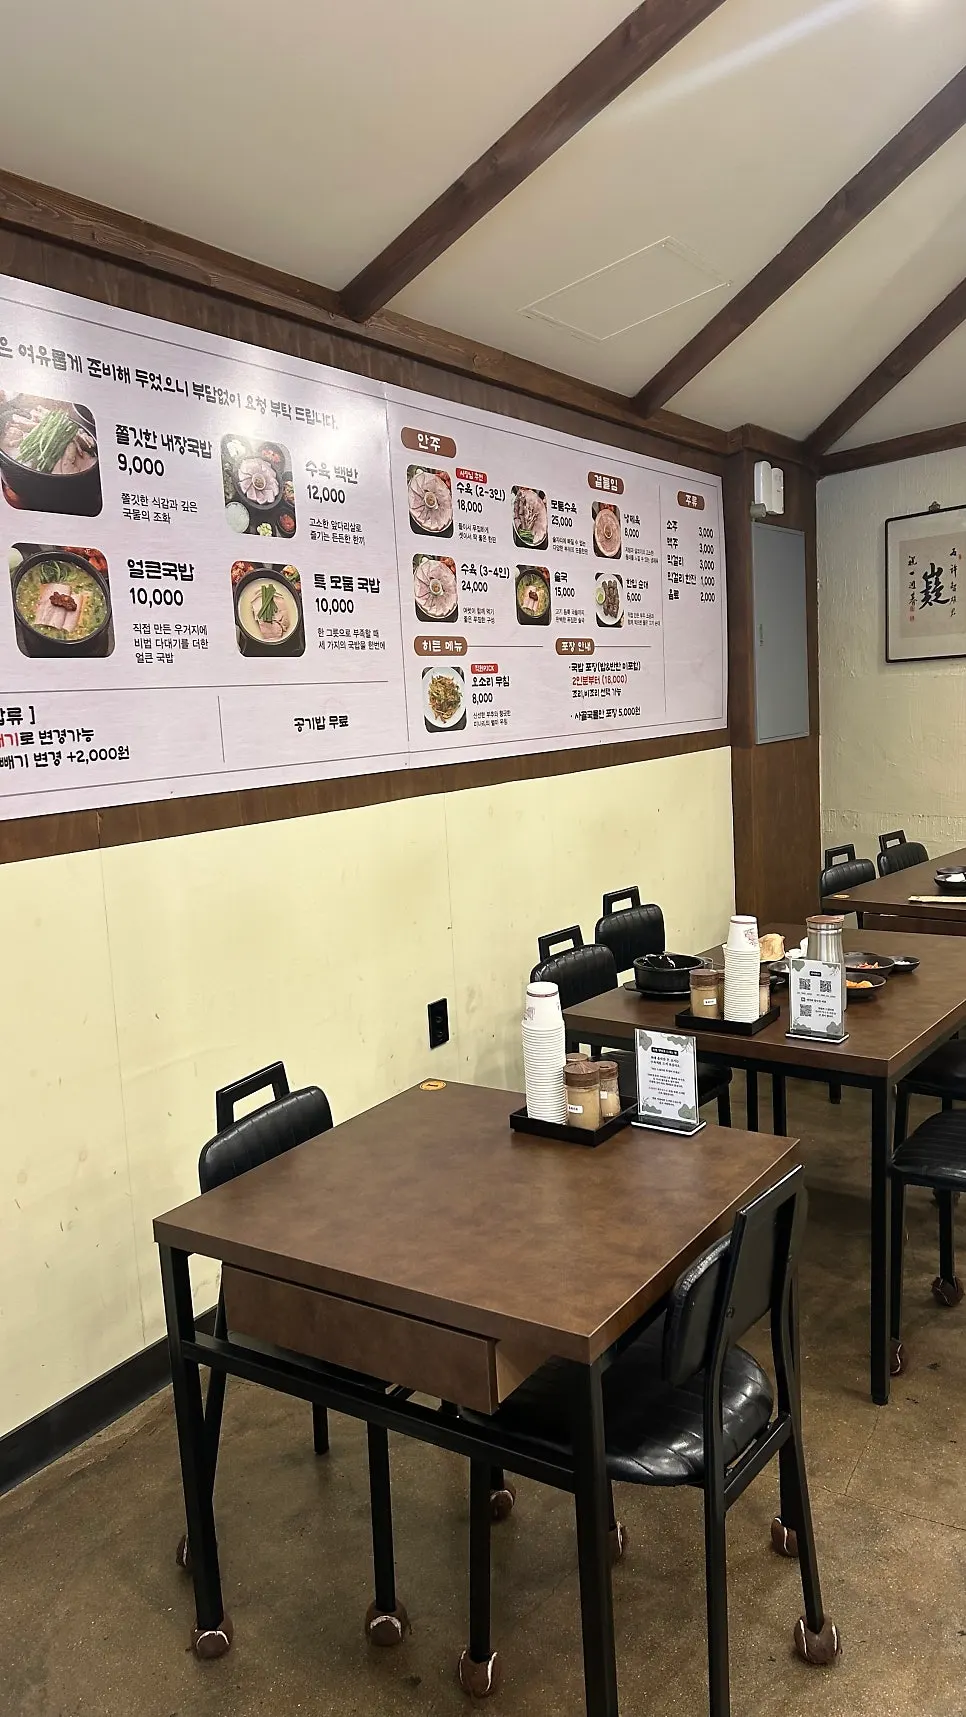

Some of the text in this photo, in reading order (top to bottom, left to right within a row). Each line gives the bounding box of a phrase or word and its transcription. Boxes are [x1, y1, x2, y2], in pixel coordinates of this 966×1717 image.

[18, 344, 83, 373] 여유롭게
[86, 357, 131, 384] 준비해
[135, 368, 189, 397] 두었으니
[192, 381, 241, 408] 부담없이
[244, 395, 267, 415] 요청
[270, 401, 292, 421] 부탁
[295, 406, 339, 430] 드립니다.
[115, 424, 212, 459] 쫄깃한 내장국밥
[417, 433, 441, 452] 안주
[117, 453, 165, 477] 9,000
[305, 460, 358, 485] 수육 백반
[306, 484, 346, 504] 12,000
[456, 481, 506, 502] 수육 (2-3인)
[121, 492, 198, 513] 쫄깃한 식감과 깊은
[457, 499, 483, 513] 18,000
[550, 499, 577, 514] 모둠수육
[685, 494, 698, 507] 주류
[122, 507, 171, 524] 국물의 조화
[551, 514, 573, 528] 25,000
[309, 517, 362, 533] 고소한 앞다리살로
[666, 520, 714, 539] 소주 3,000
[310, 530, 330, 542] 즐기는
[332, 532, 351, 544] 든든한
[667, 537, 714, 555] 맥주 3,000
[127, 559, 195, 581] 얼큰국밥
[460, 563, 510, 580] 수육 (3-4인)
[667, 555, 684, 567] 막걸리
[700, 560, 715, 572] 3,000
[314, 573, 381, 594] 특 모둠 국밥
[461, 580, 488, 593] 24,000
[667, 572, 684, 584] 막걸리
[700, 576, 716, 588] 1,000
[129, 587, 184, 608] 10,000
[554, 586, 576, 598] 15,000
[668, 589, 716, 603] 음료 2,000
[315, 597, 355, 615] 10,000
[132, 623, 208, 636] 직접 만든 우거지에
[317, 627, 324, 638] 한
[326, 628, 352, 638] 그릇으로
[133, 638, 209, 650] 비법 다대기를 더한
[327, 640, 347, 650] 가지의
[422, 640, 463, 652] 히든 메뉴
[561, 641, 592, 653] 포장 안내
[135, 652, 174, 664] 얼큰 국밥
[471, 676, 510, 688] 오소리 무침
[601, 674, 628, 686] (18,000)
[471, 692, 494, 706] 8,000
[293, 715, 349, 733] 공기밥 무료
[38, 728, 95, 746] 변경가능
[33, 750, 62, 768] 변경
[66, 746, 130, 765] +2,000원
